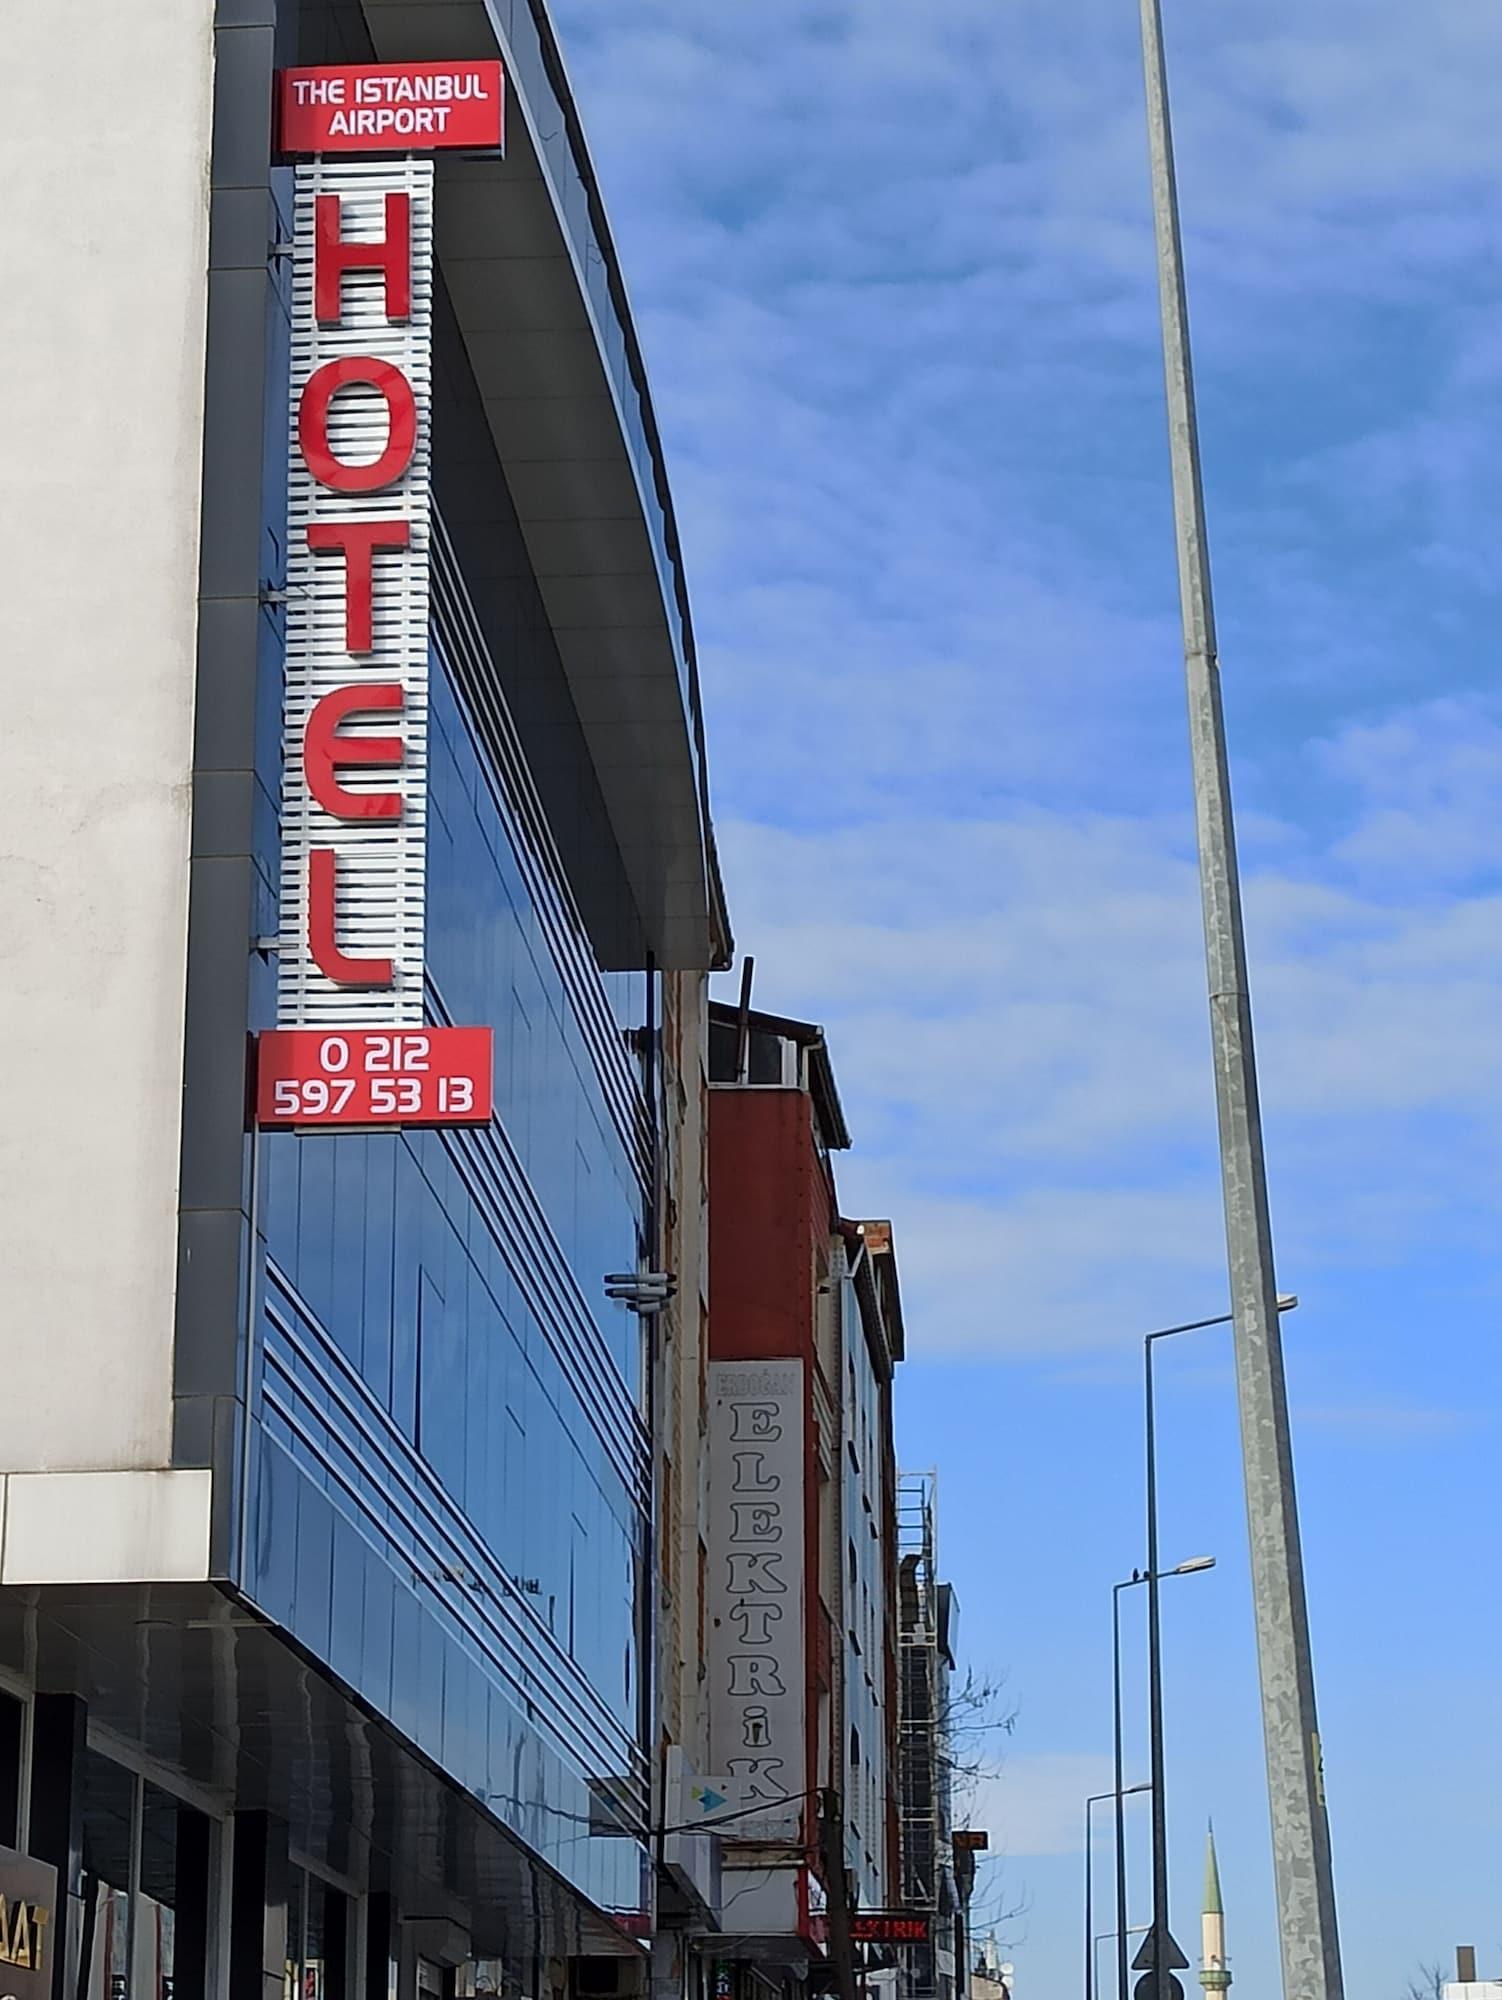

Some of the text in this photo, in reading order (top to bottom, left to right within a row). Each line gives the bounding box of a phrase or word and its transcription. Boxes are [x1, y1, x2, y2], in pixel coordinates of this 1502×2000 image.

[292, 73, 489, 105] THE ISTANBUL
[328, 106, 451, 136] AIRPORT
[297, 192, 418, 988] HOTEL
[319, 1035, 430, 1072] 0 212
[273, 1076, 474, 1115] 597 53 13
